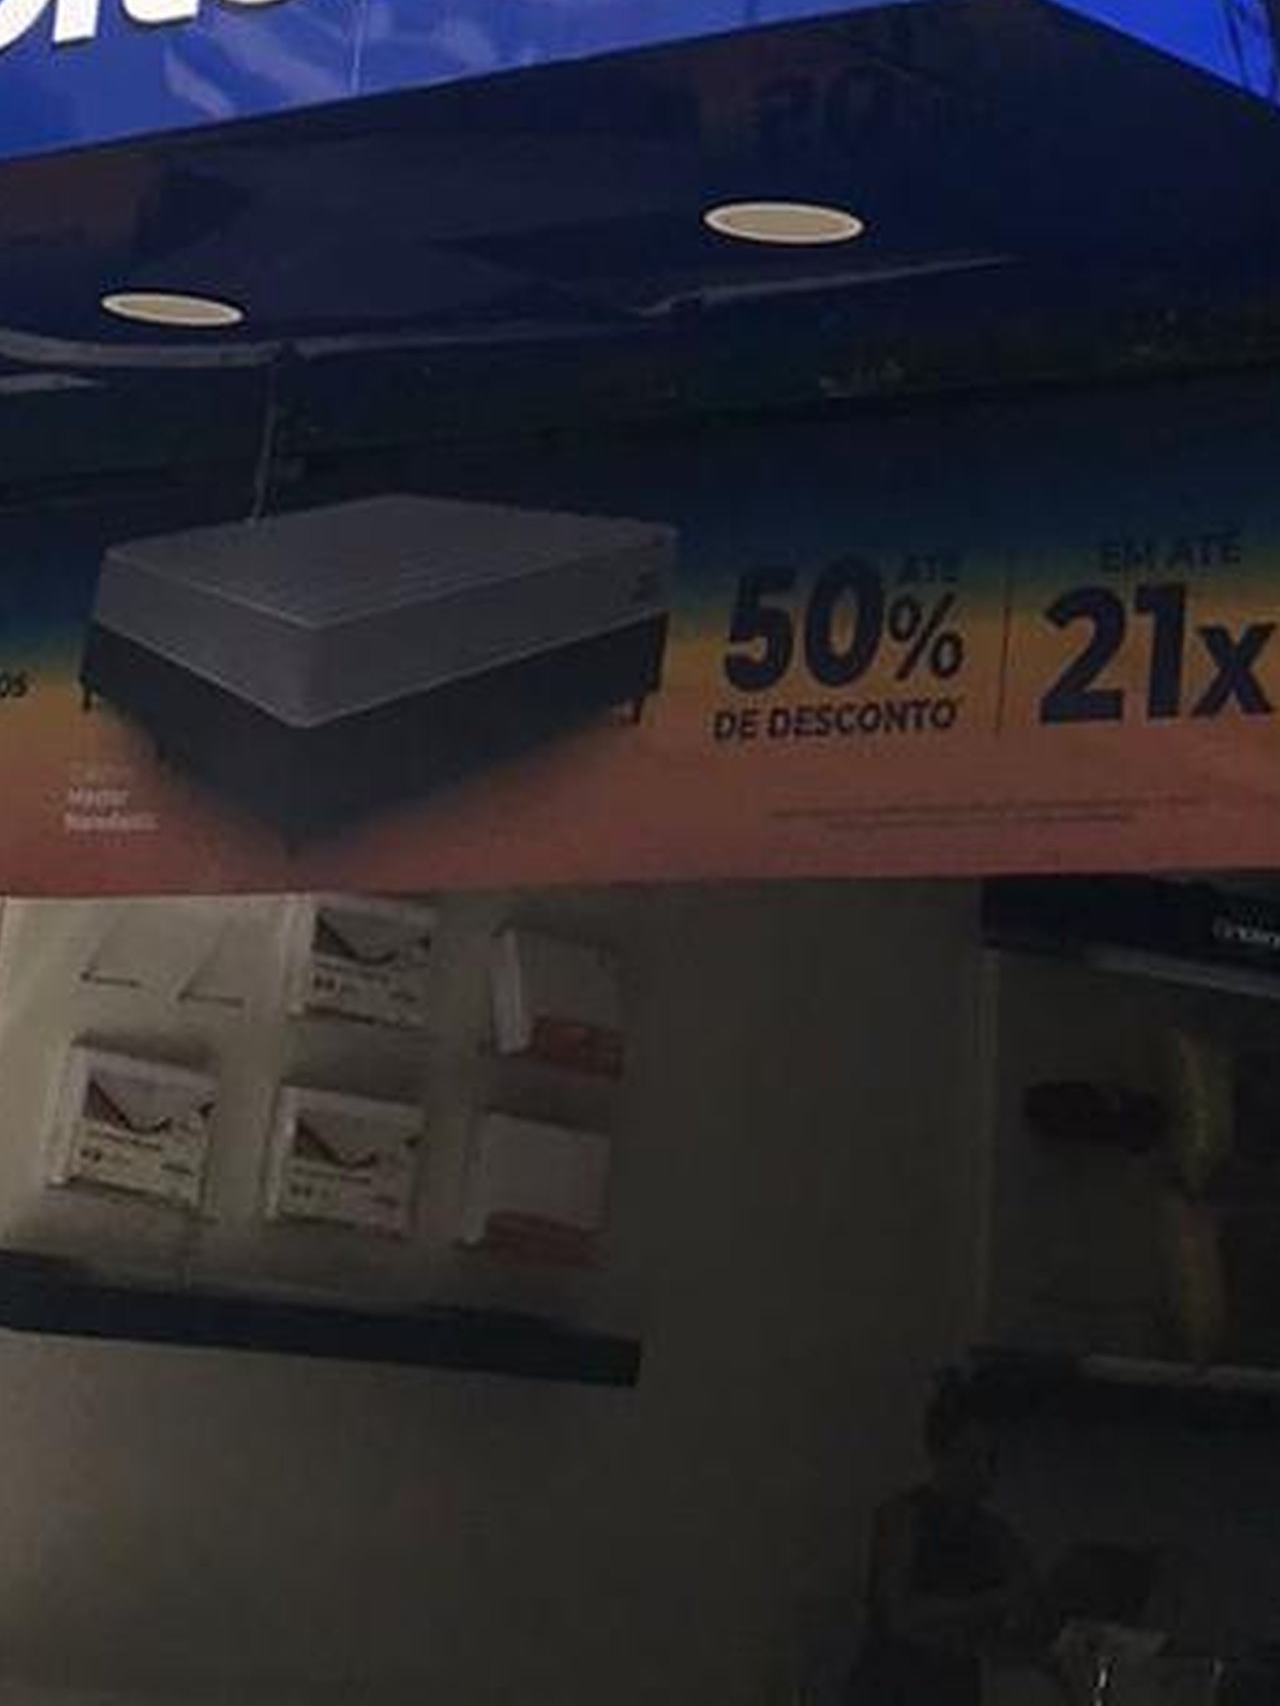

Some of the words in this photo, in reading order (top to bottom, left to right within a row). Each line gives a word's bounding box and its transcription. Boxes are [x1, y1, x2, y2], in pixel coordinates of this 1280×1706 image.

[723, 556, 964, 691] 50%
[1039, 582, 1278, 727] 21x
[713, 709, 758, 741] DE
